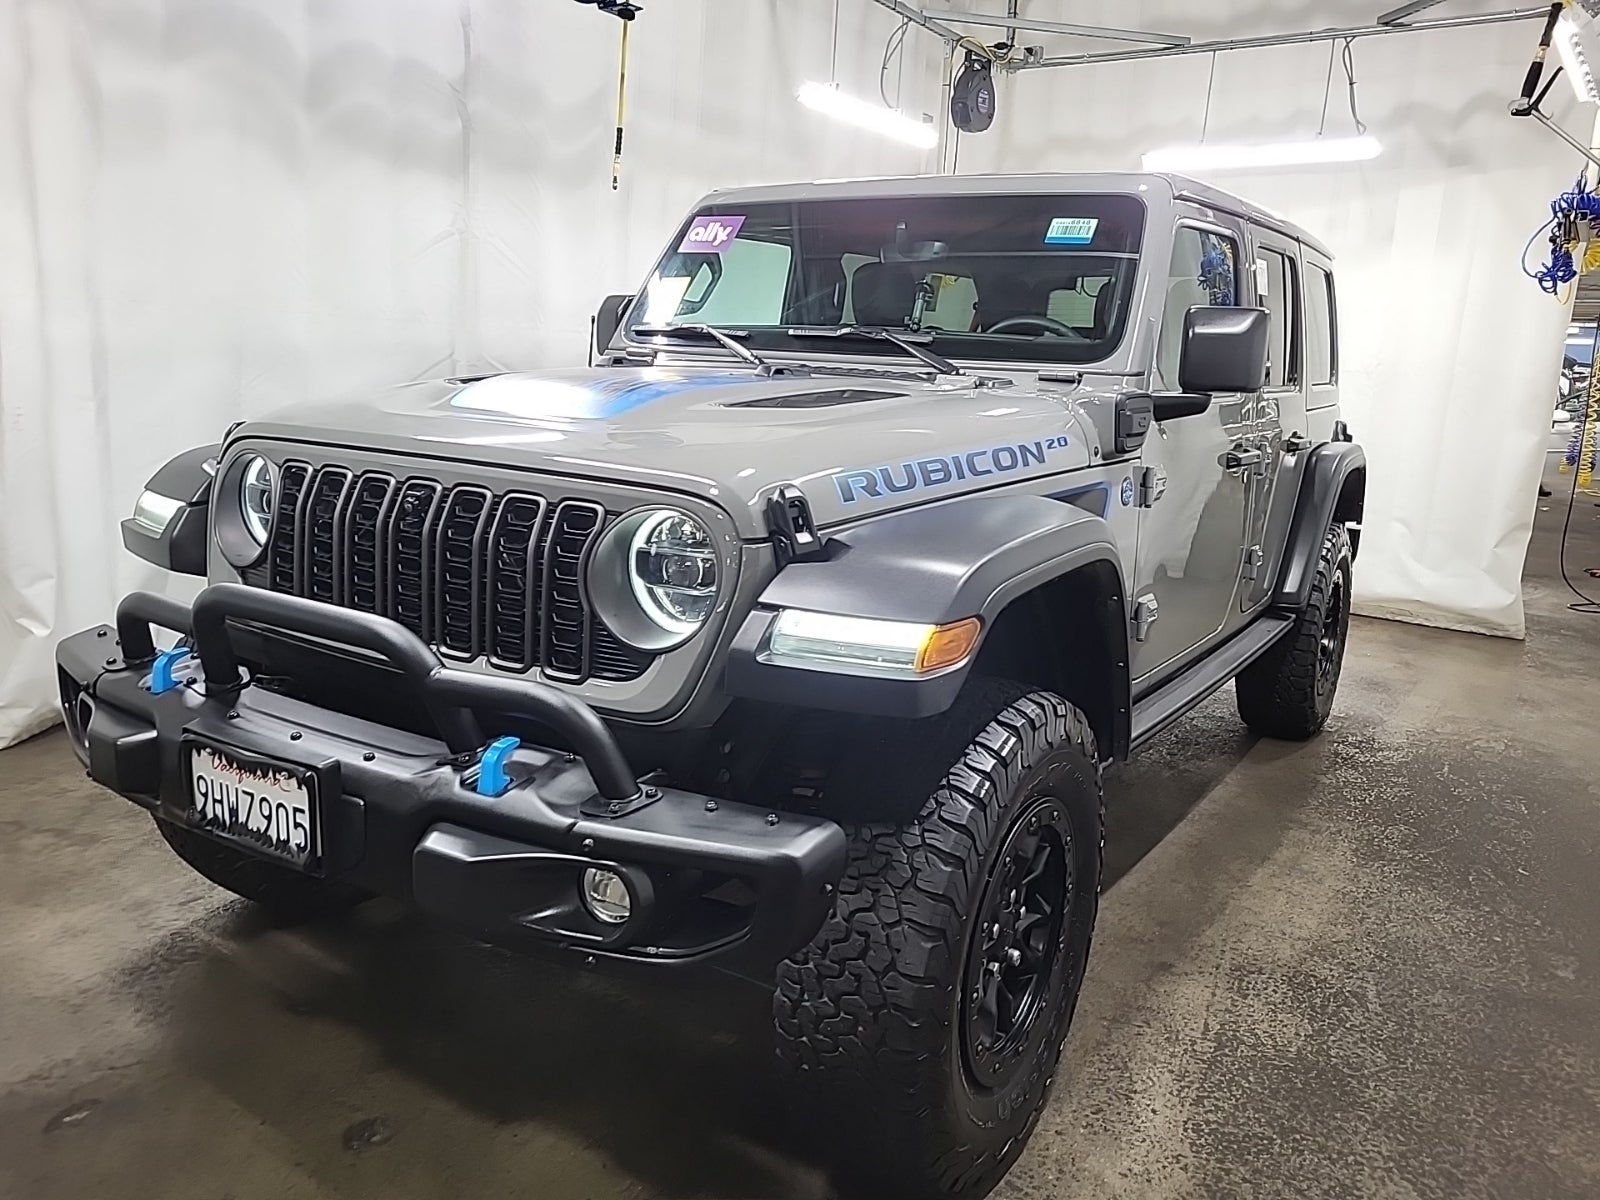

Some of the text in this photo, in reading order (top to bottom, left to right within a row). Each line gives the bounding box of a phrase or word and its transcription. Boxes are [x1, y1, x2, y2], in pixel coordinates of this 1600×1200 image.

[689, 222, 733, 246] ally
[833, 436, 1068, 503] RUBICON 20
[196, 774, 309, 855] 9HW7905
